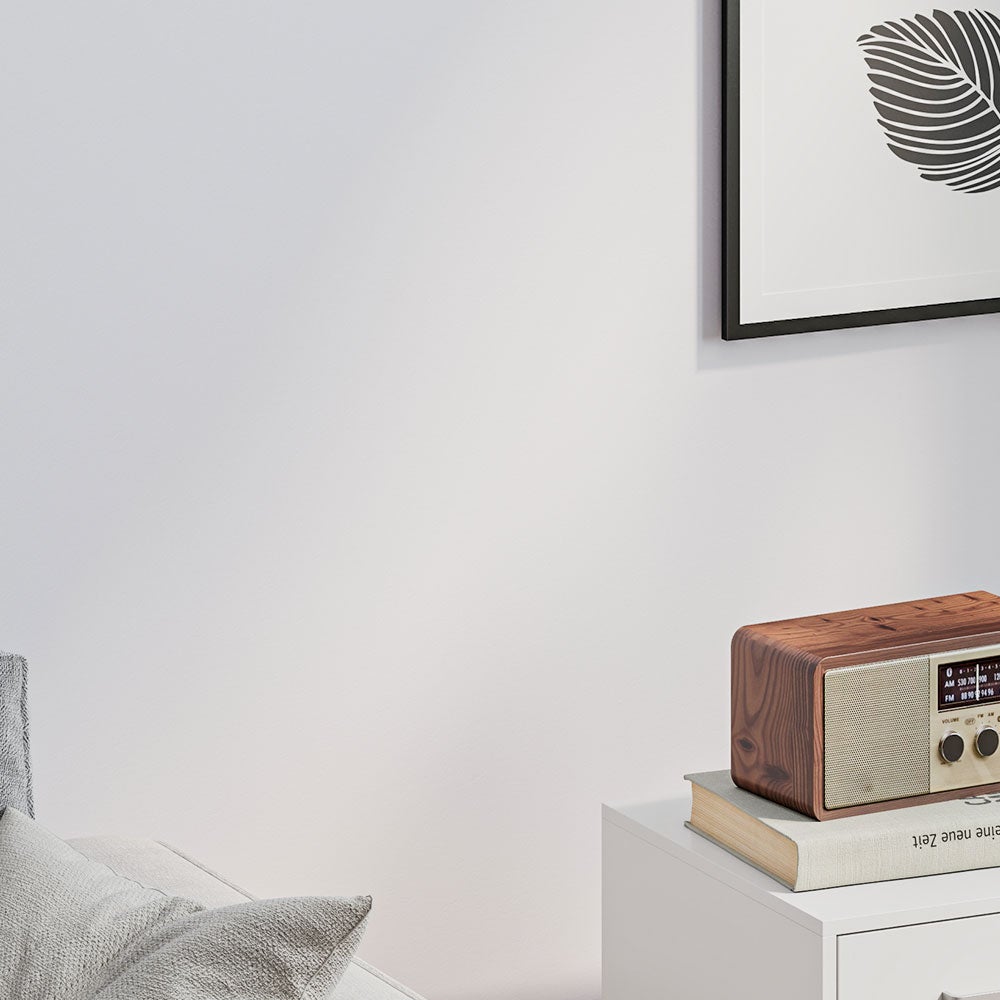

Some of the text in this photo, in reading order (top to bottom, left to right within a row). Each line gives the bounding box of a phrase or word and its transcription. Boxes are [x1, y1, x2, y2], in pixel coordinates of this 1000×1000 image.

[944, 679, 955, 688] AM
[957, 678, 966, 687] 530
[944, 694, 955, 702] FM
[912, 833, 937, 849] Zeit
[941, 829, 971, 843] neue
